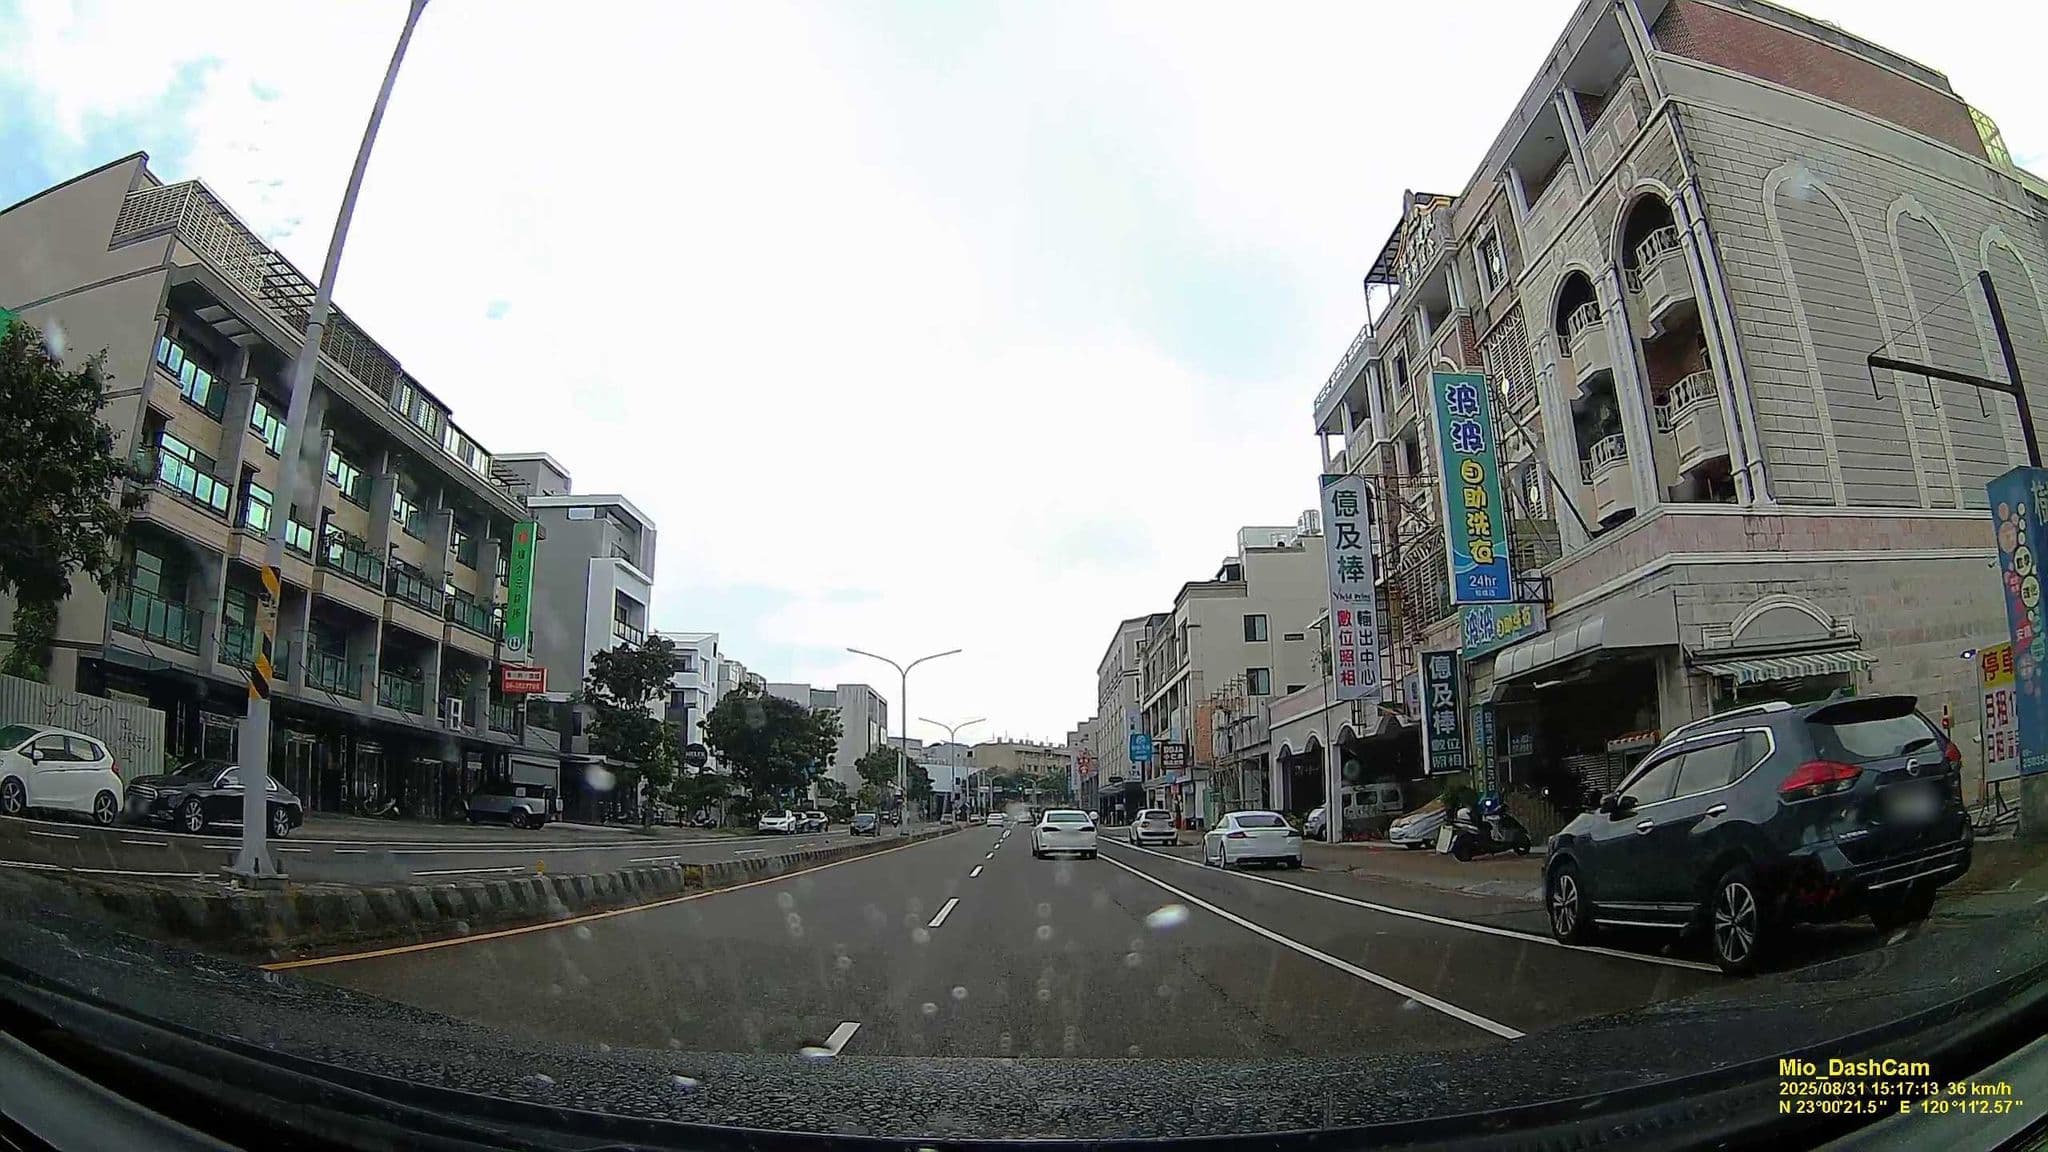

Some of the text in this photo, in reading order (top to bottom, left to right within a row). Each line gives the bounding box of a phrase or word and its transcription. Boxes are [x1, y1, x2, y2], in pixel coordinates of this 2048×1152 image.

[1331, 489, 1365, 583] 億及棒
[1469, 574, 1497, 587] 24hr
[1337, 609, 1356, 686] 數位照相
[1357, 609, 1376, 686] 輸出中心
[1429, 656, 1456, 734] 億及棒
